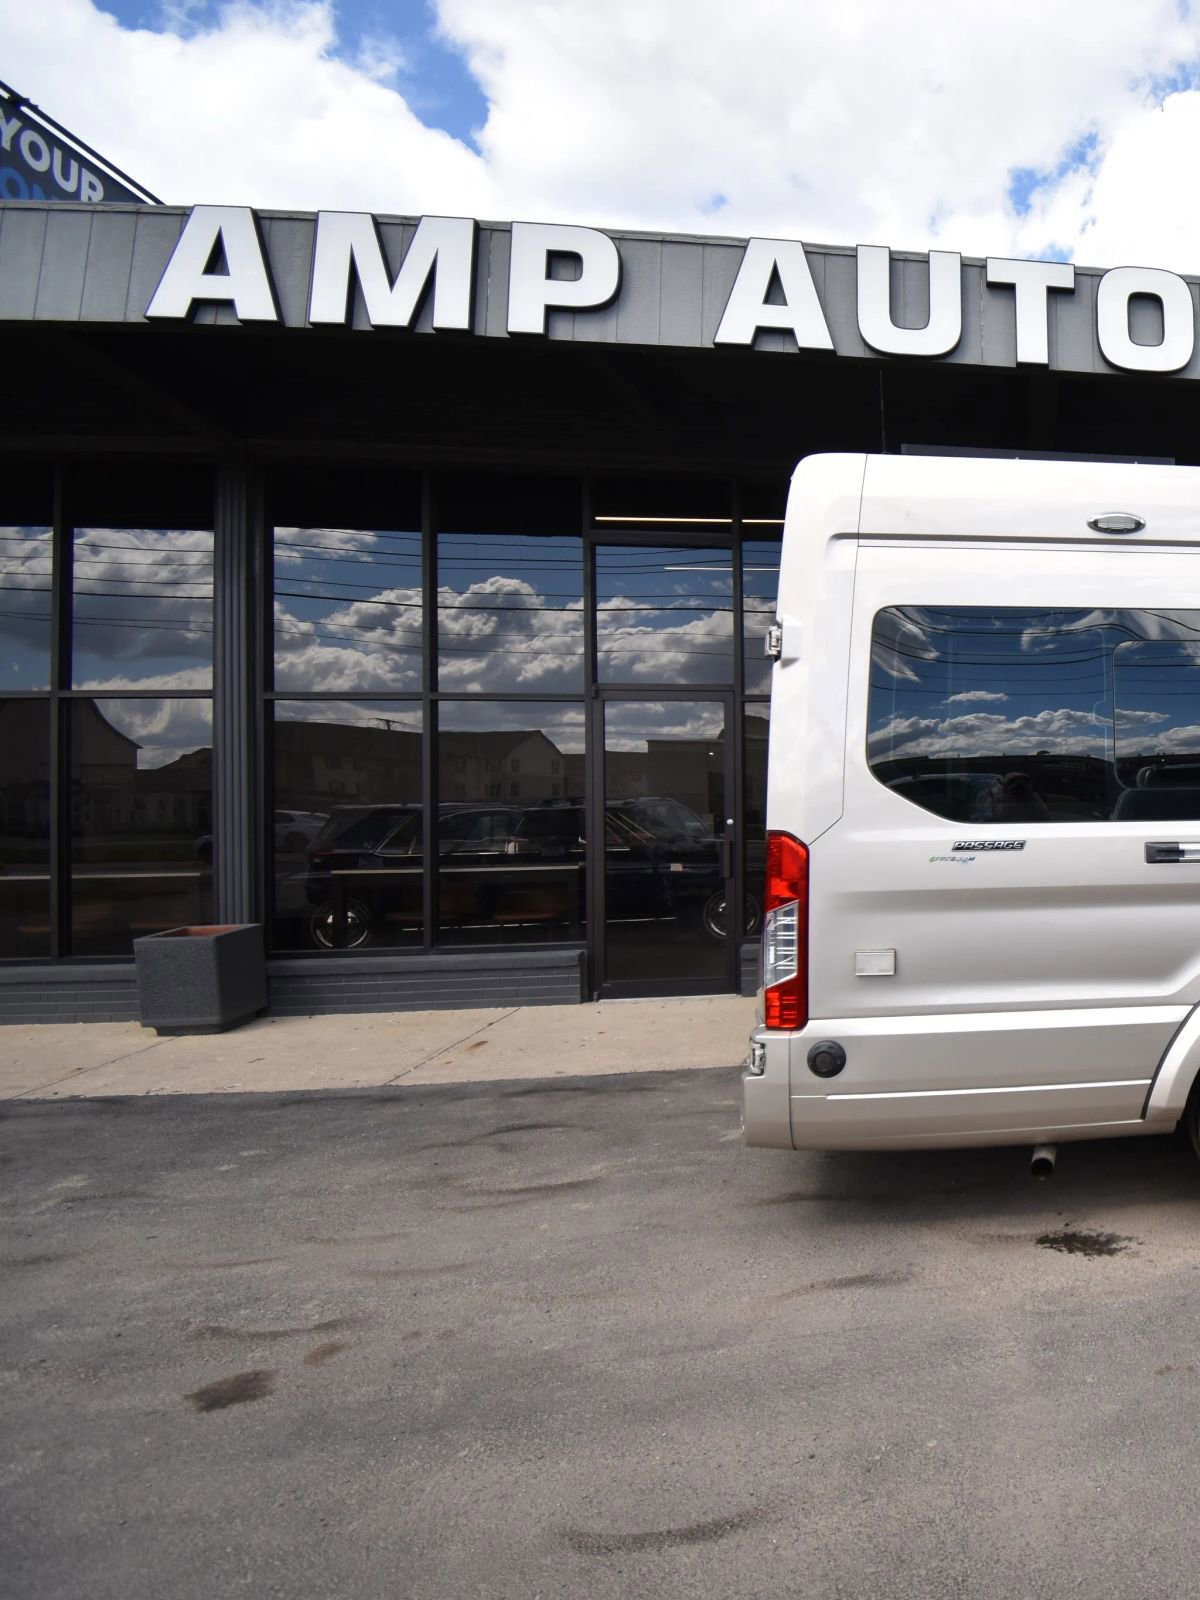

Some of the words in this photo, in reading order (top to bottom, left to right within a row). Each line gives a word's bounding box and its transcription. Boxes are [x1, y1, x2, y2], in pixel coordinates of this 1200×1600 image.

[0, 108, 104, 202] YOUR
[145, 205, 622, 338] AMP
[713, 237, 1195, 374] AUTO
[953, 840, 1026, 850] PASSAGE
